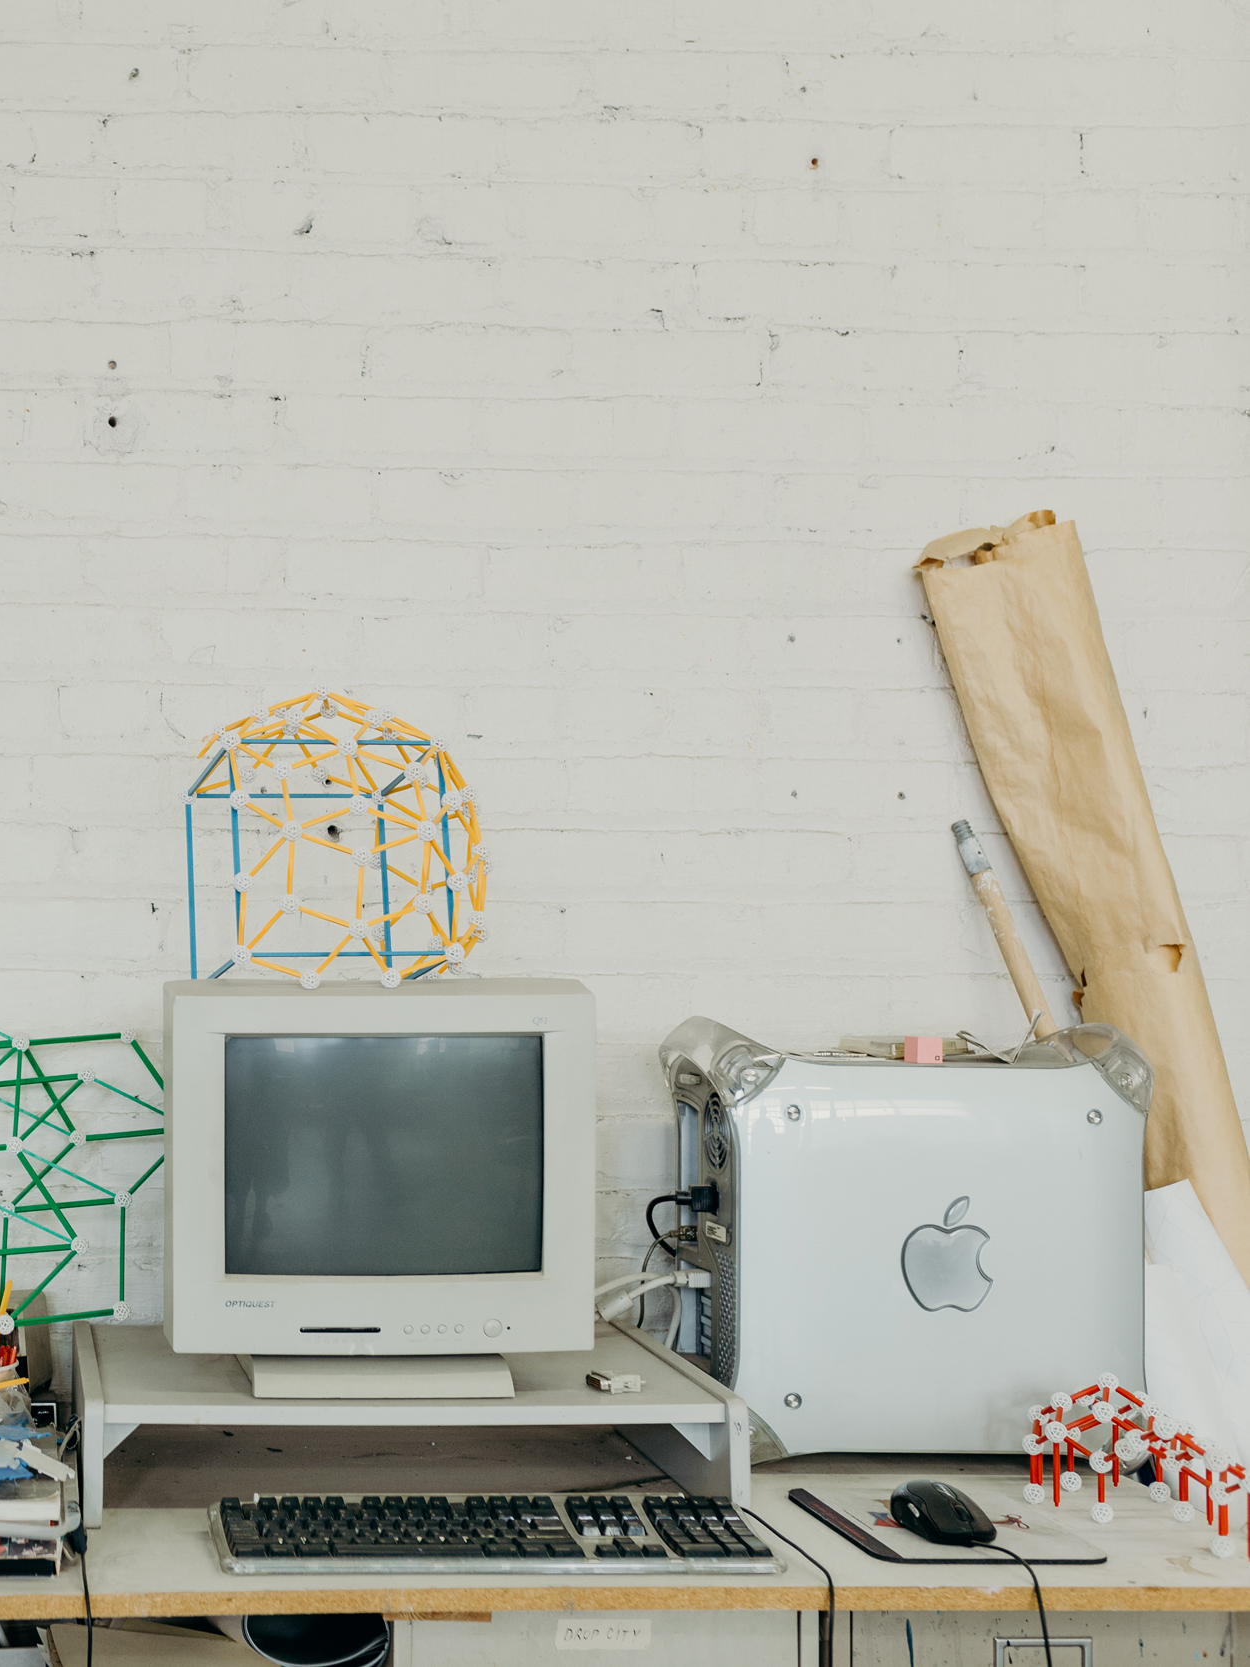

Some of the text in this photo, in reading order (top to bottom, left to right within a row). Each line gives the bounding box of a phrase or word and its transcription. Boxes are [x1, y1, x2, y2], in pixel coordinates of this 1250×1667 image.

[225, 1300, 276, 1308] OPTIQUEST
[563, 1627, 642, 1643] DROP CITY
